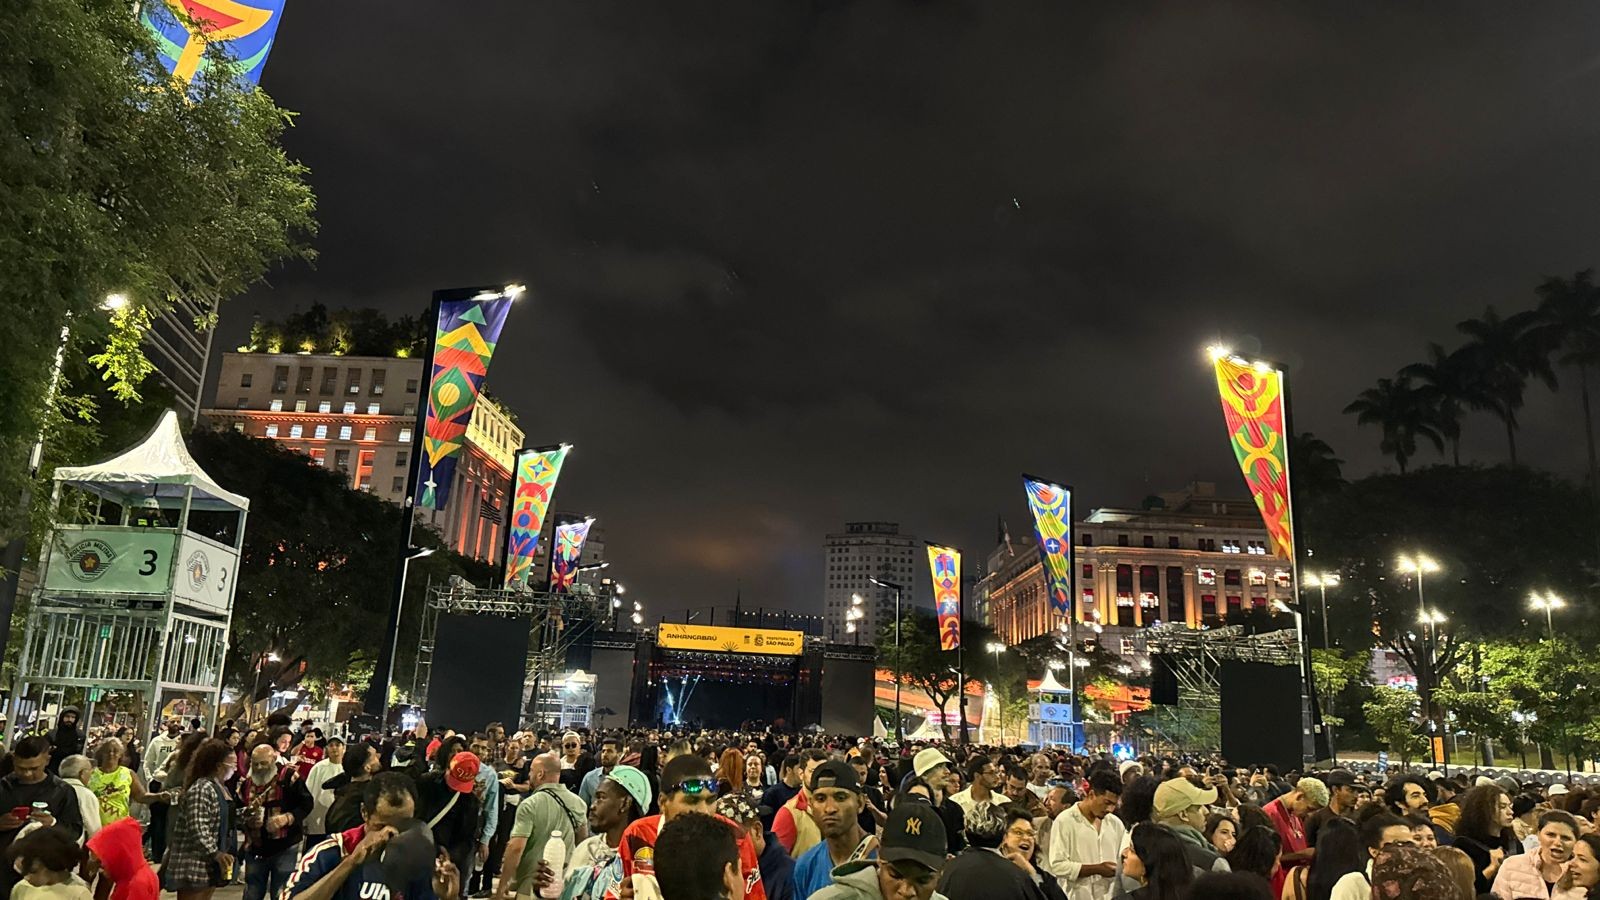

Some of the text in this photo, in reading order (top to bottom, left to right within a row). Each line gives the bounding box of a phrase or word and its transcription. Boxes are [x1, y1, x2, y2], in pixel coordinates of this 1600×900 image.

[139, 549, 158, 576] 3
[217, 567, 227, 592] 3
[1063, 709, 1068, 718] 2
[905, 816, 922, 835] NY
